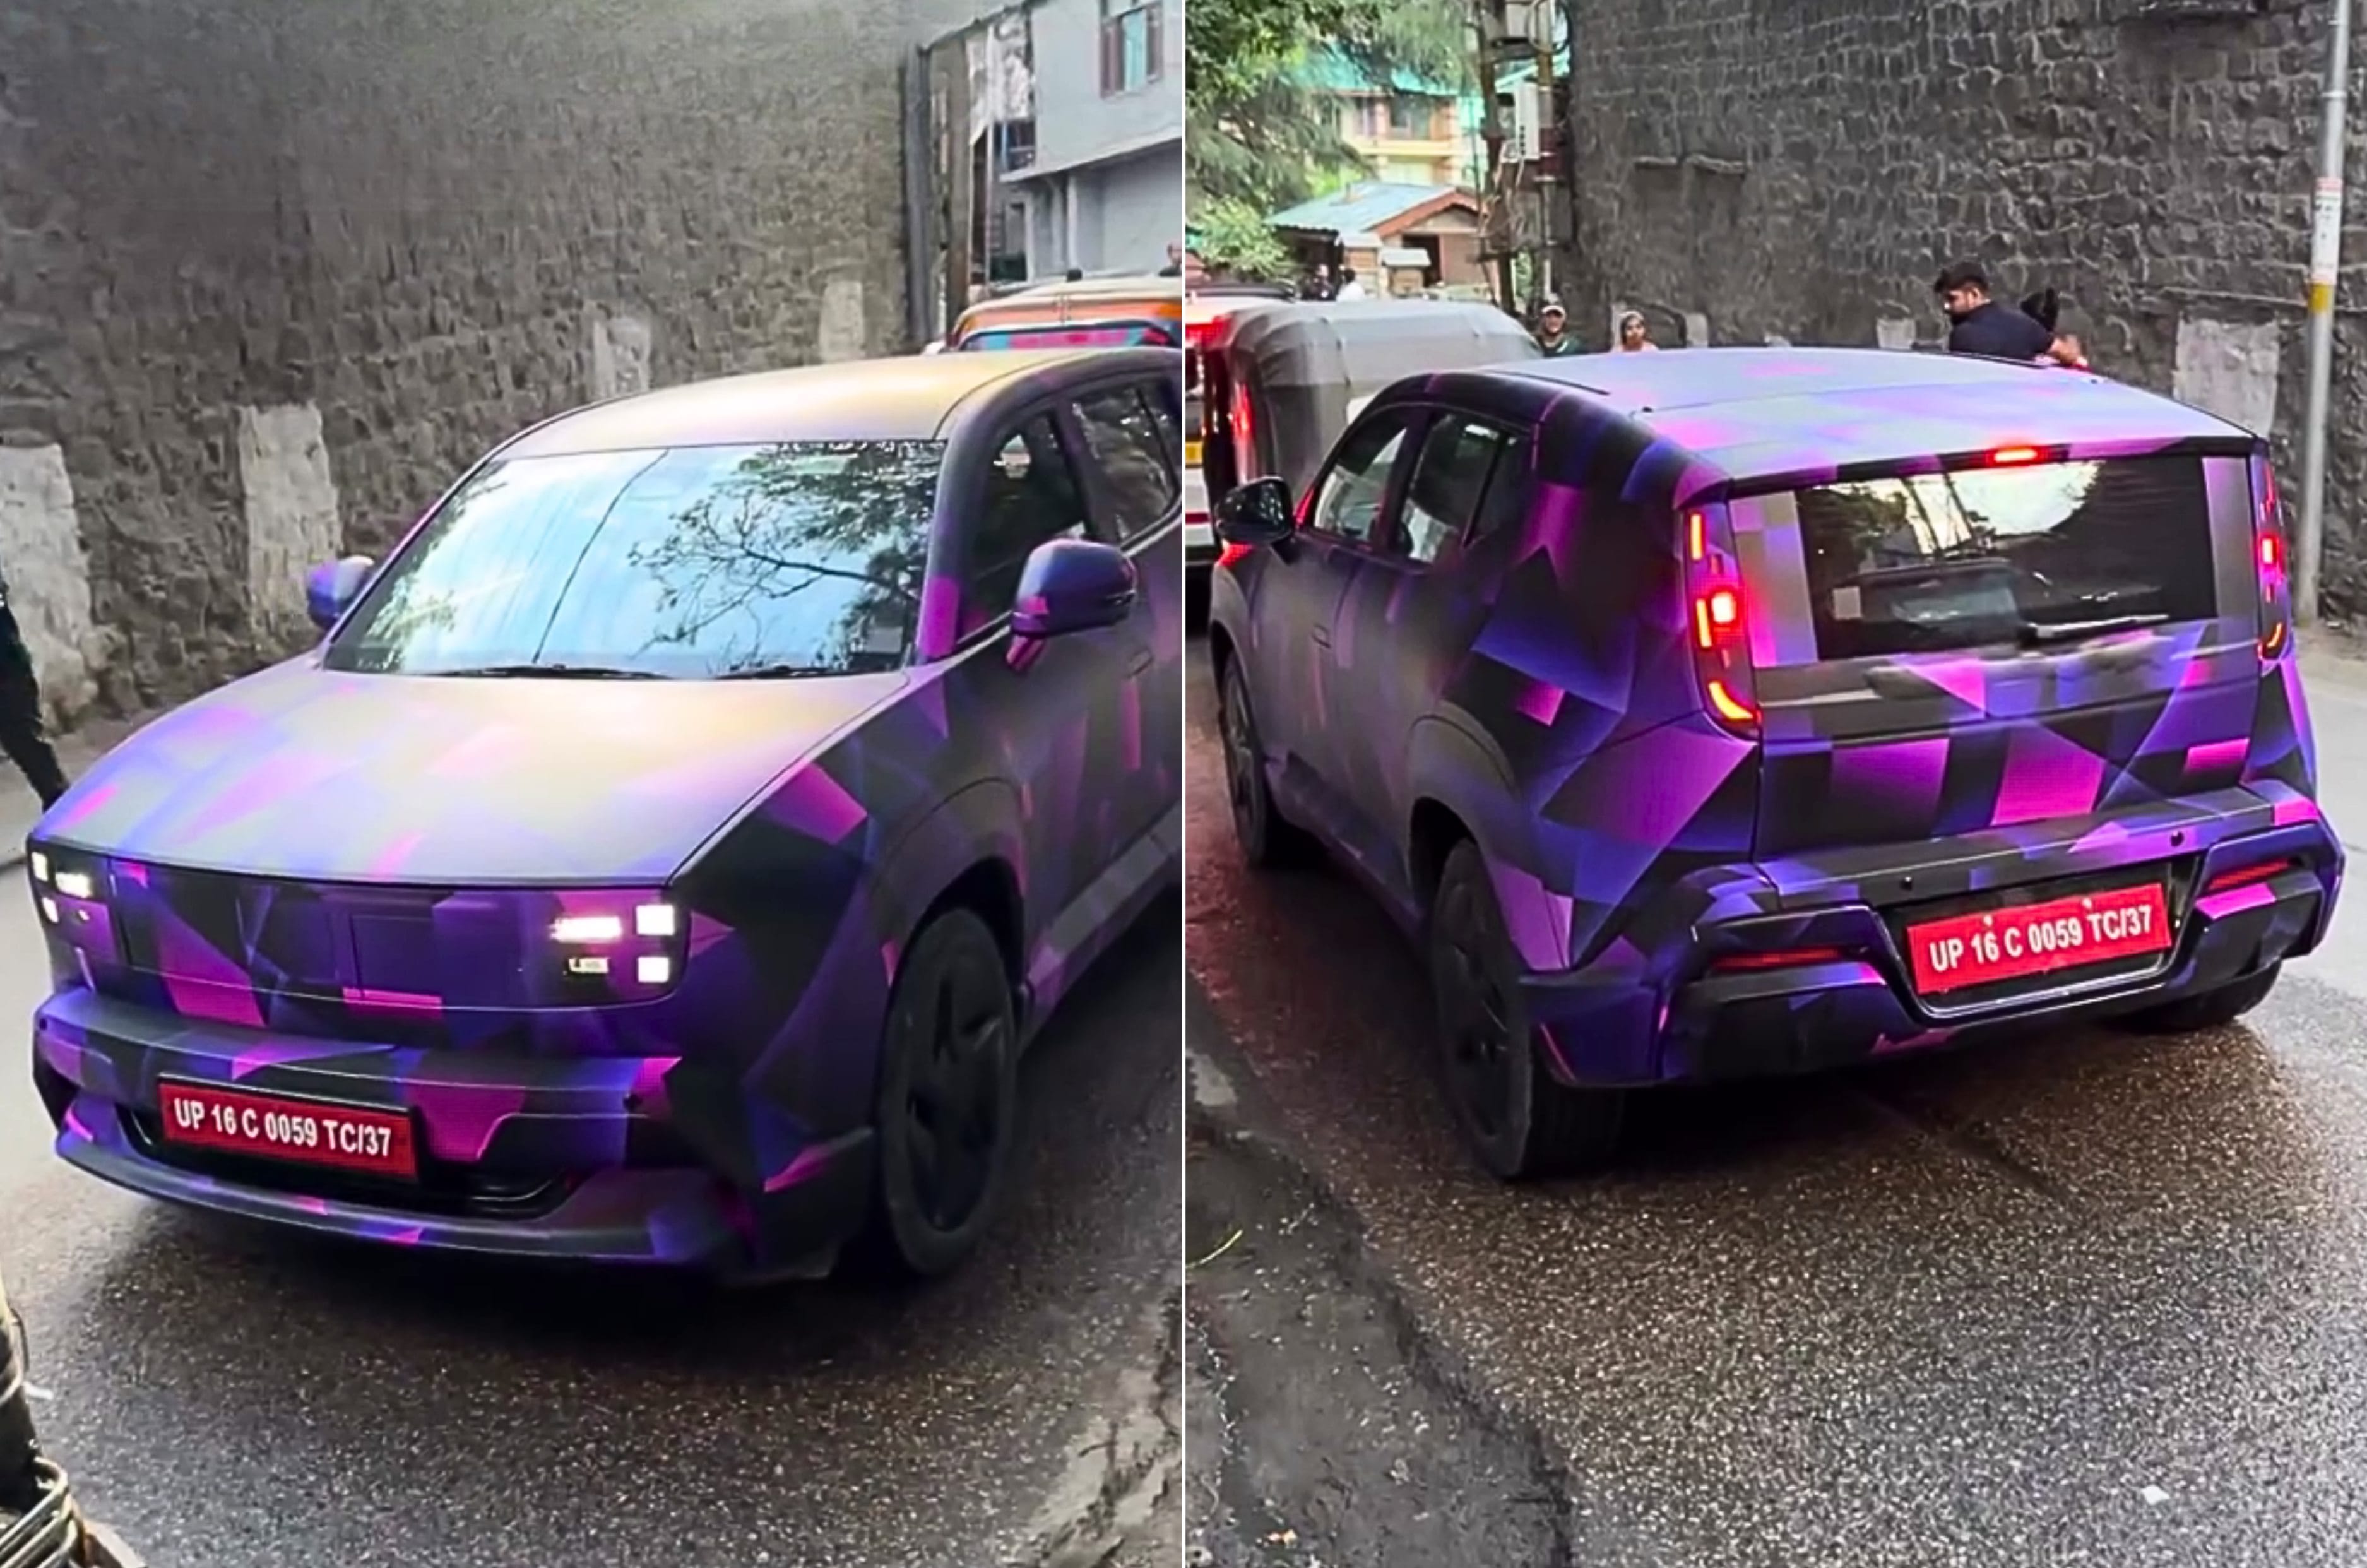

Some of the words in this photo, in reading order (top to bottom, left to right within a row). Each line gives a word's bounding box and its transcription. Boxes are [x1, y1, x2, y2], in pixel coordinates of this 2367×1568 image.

[1930, 938, 1963, 972] UP
[1970, 932, 2000, 963] 16
[2004, 927, 2023, 957] C
[2028, 917, 2084, 953] 0059
[2087, 905, 2152, 942] TC/37
[174, 1098, 205, 1129] UP
[211, 1104, 237, 1135] 16
[242, 1108, 259, 1138] C
[264, 1112, 318, 1147] 0059
[322, 1119, 391, 1156] TC/37
